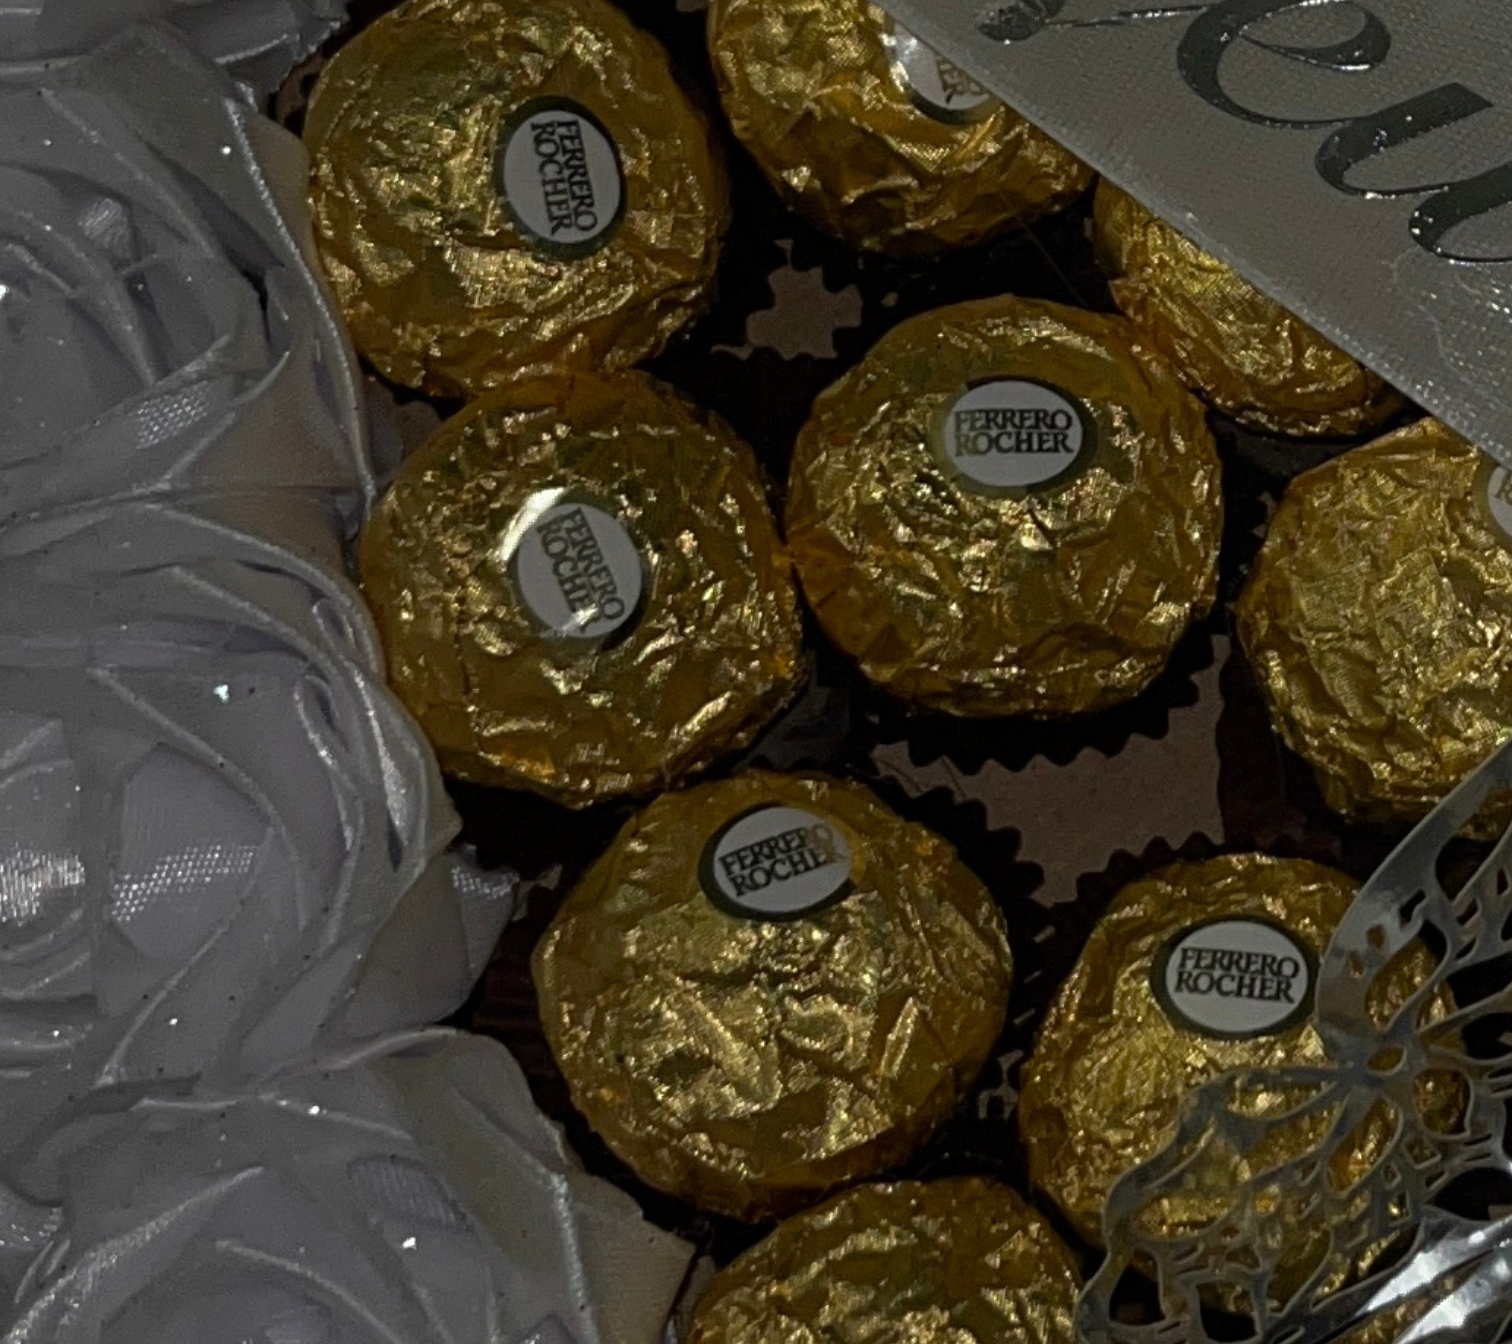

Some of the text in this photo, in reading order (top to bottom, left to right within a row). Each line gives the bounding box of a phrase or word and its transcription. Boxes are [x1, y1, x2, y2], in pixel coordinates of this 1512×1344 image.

[531, 121, 574, 235] ROCHER
[555, 119, 598, 232] FERRERO
[954, 408, 1073, 432] FERRERO
[955, 431, 1074, 457] ROCHER
[562, 507, 625, 620] FERRERO
[1177, 947, 1299, 979] FERRERO
[1174, 971, 1295, 1004] ROCHER
